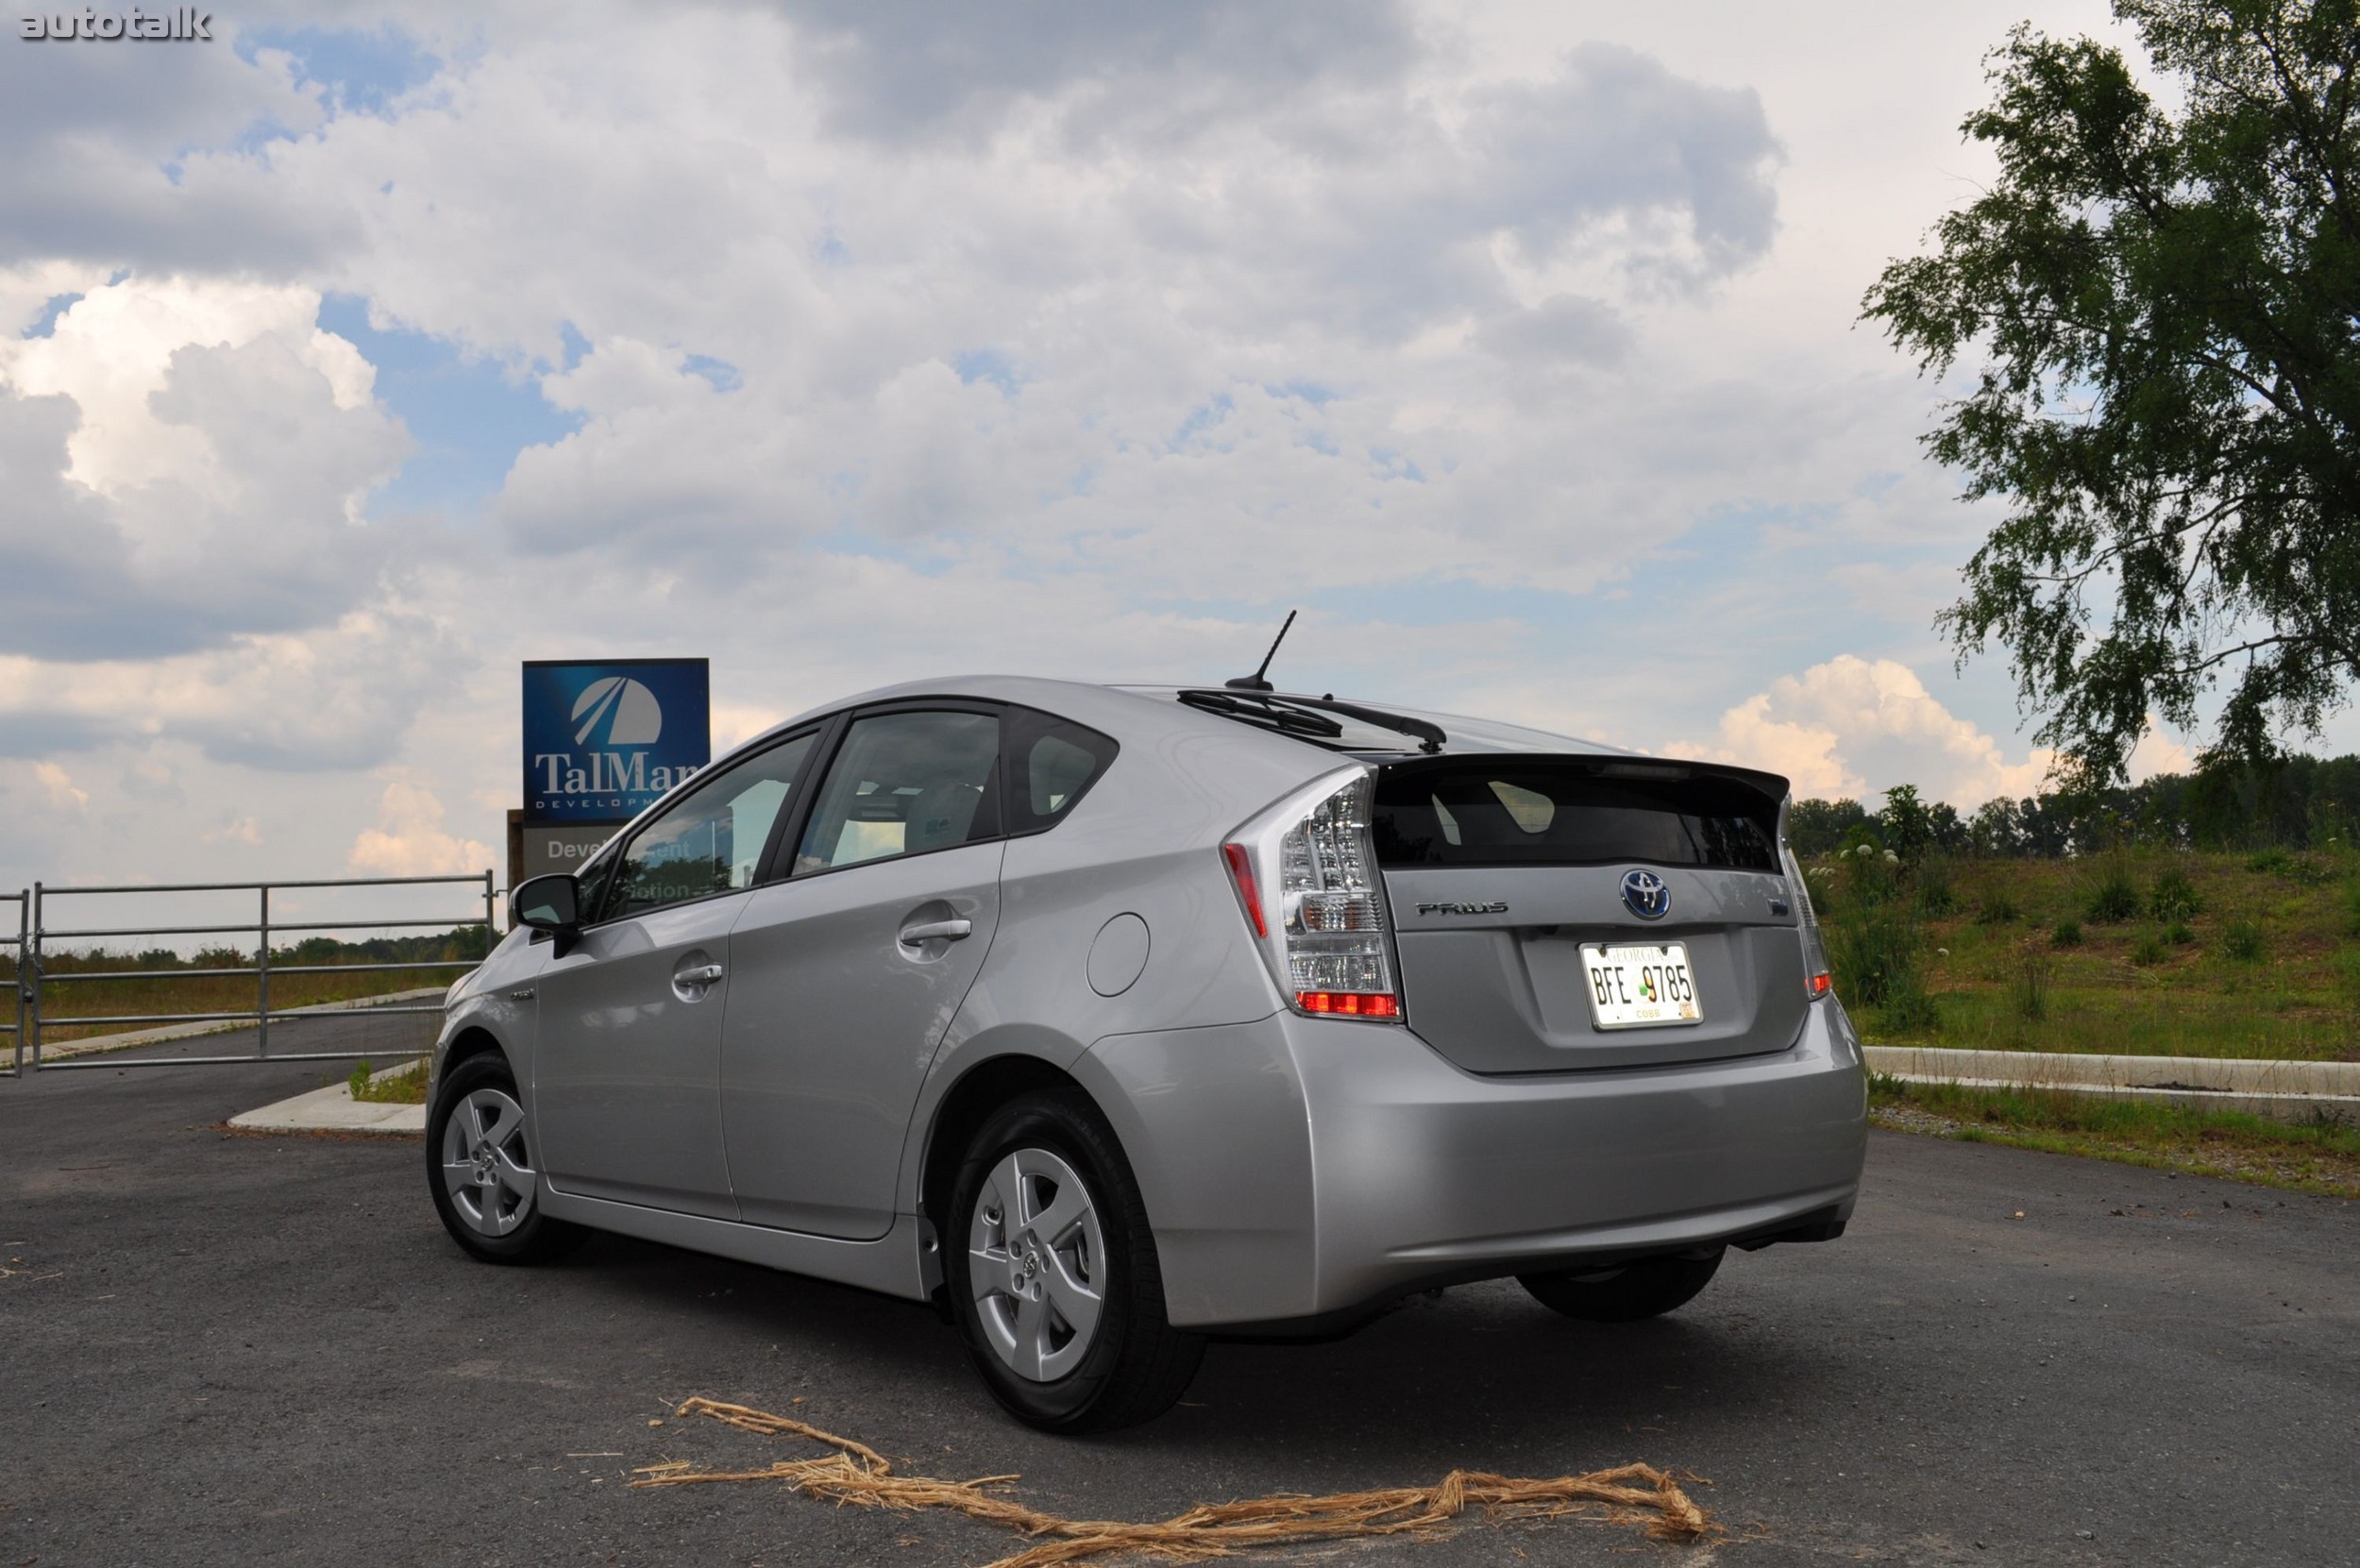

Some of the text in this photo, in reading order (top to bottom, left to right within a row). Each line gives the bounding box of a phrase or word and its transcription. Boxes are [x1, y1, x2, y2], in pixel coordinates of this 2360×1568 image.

[535, 799, 655, 809] DEVELOPM
[1416, 901, 1509, 917] PRIUS
[1591, 965, 1693, 1005] BFE 9785
[1636, 1009, 1660, 1019] COBB
